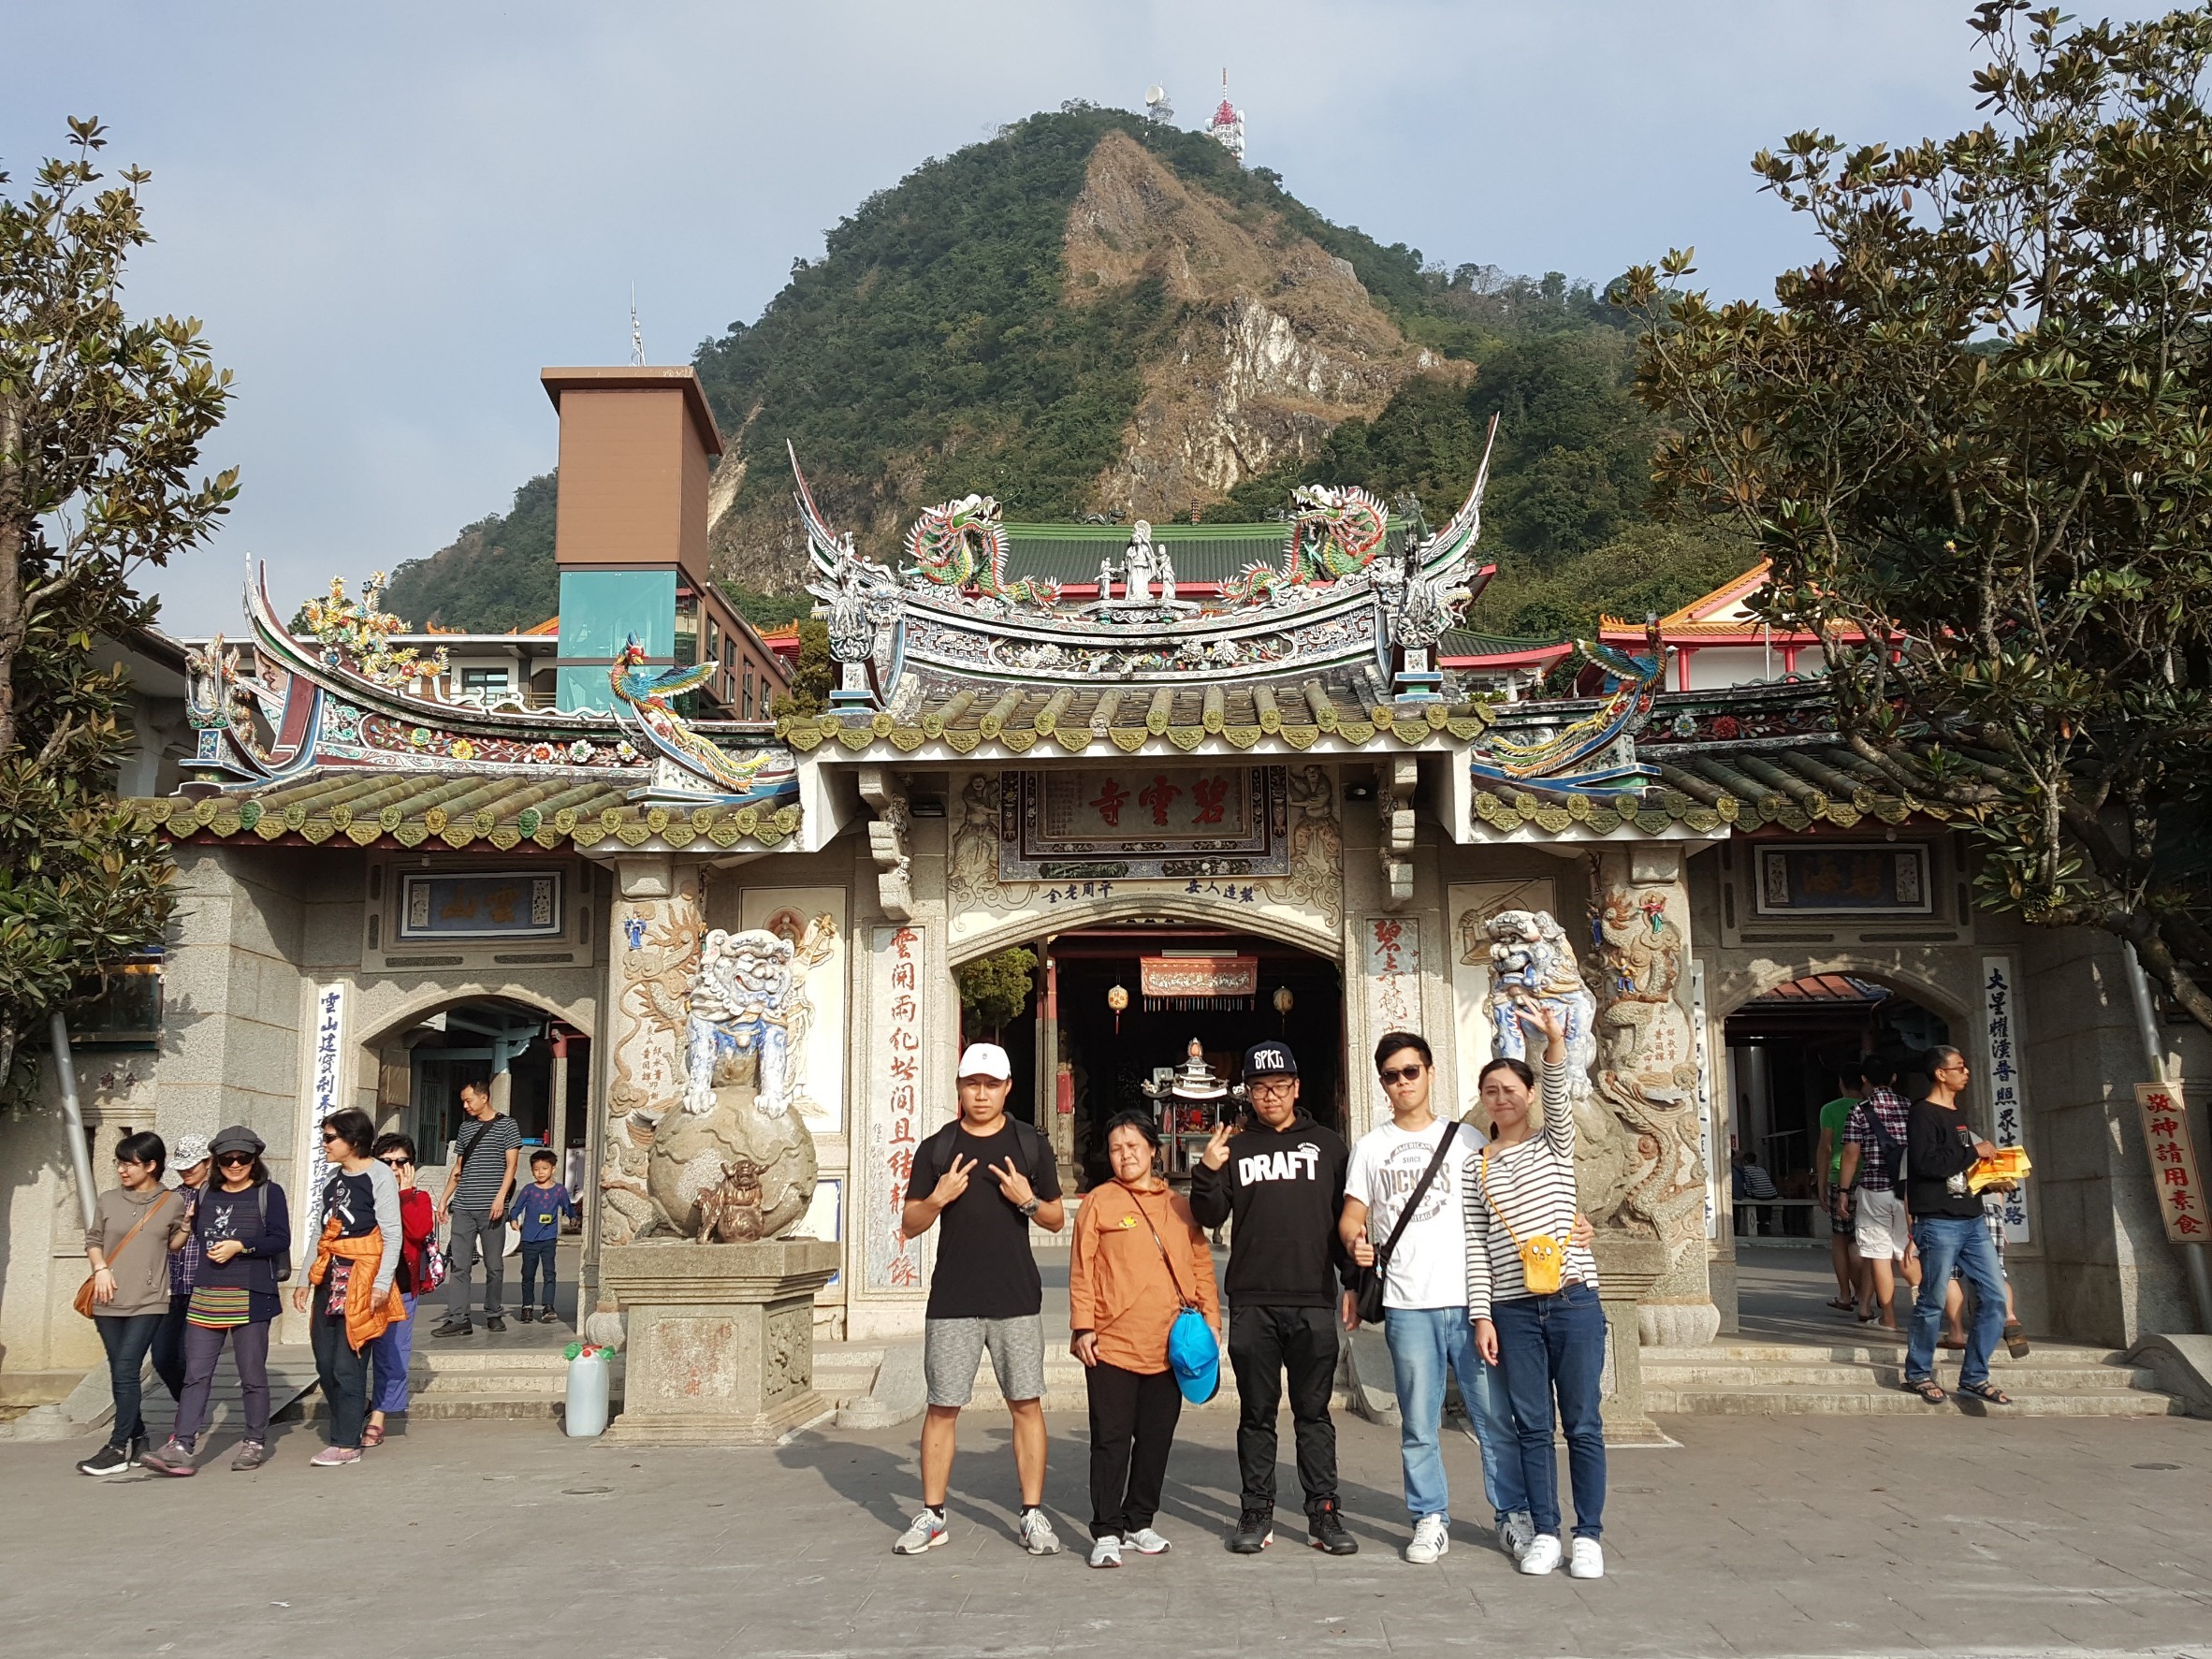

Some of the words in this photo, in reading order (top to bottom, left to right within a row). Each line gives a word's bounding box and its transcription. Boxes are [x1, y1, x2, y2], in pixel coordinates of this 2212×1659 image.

[1088, 775, 1230, 827] 碧雲寺
[1395, 1142, 1432, 1155] AMERICAN
[2146, 1093, 2205, 1235] 敬神請用素食
[1238, 1151, 1319, 1187] DRAFT
[1379, 1162, 1450, 1200] DICKS
[1403, 1195, 1432, 1207] 12
